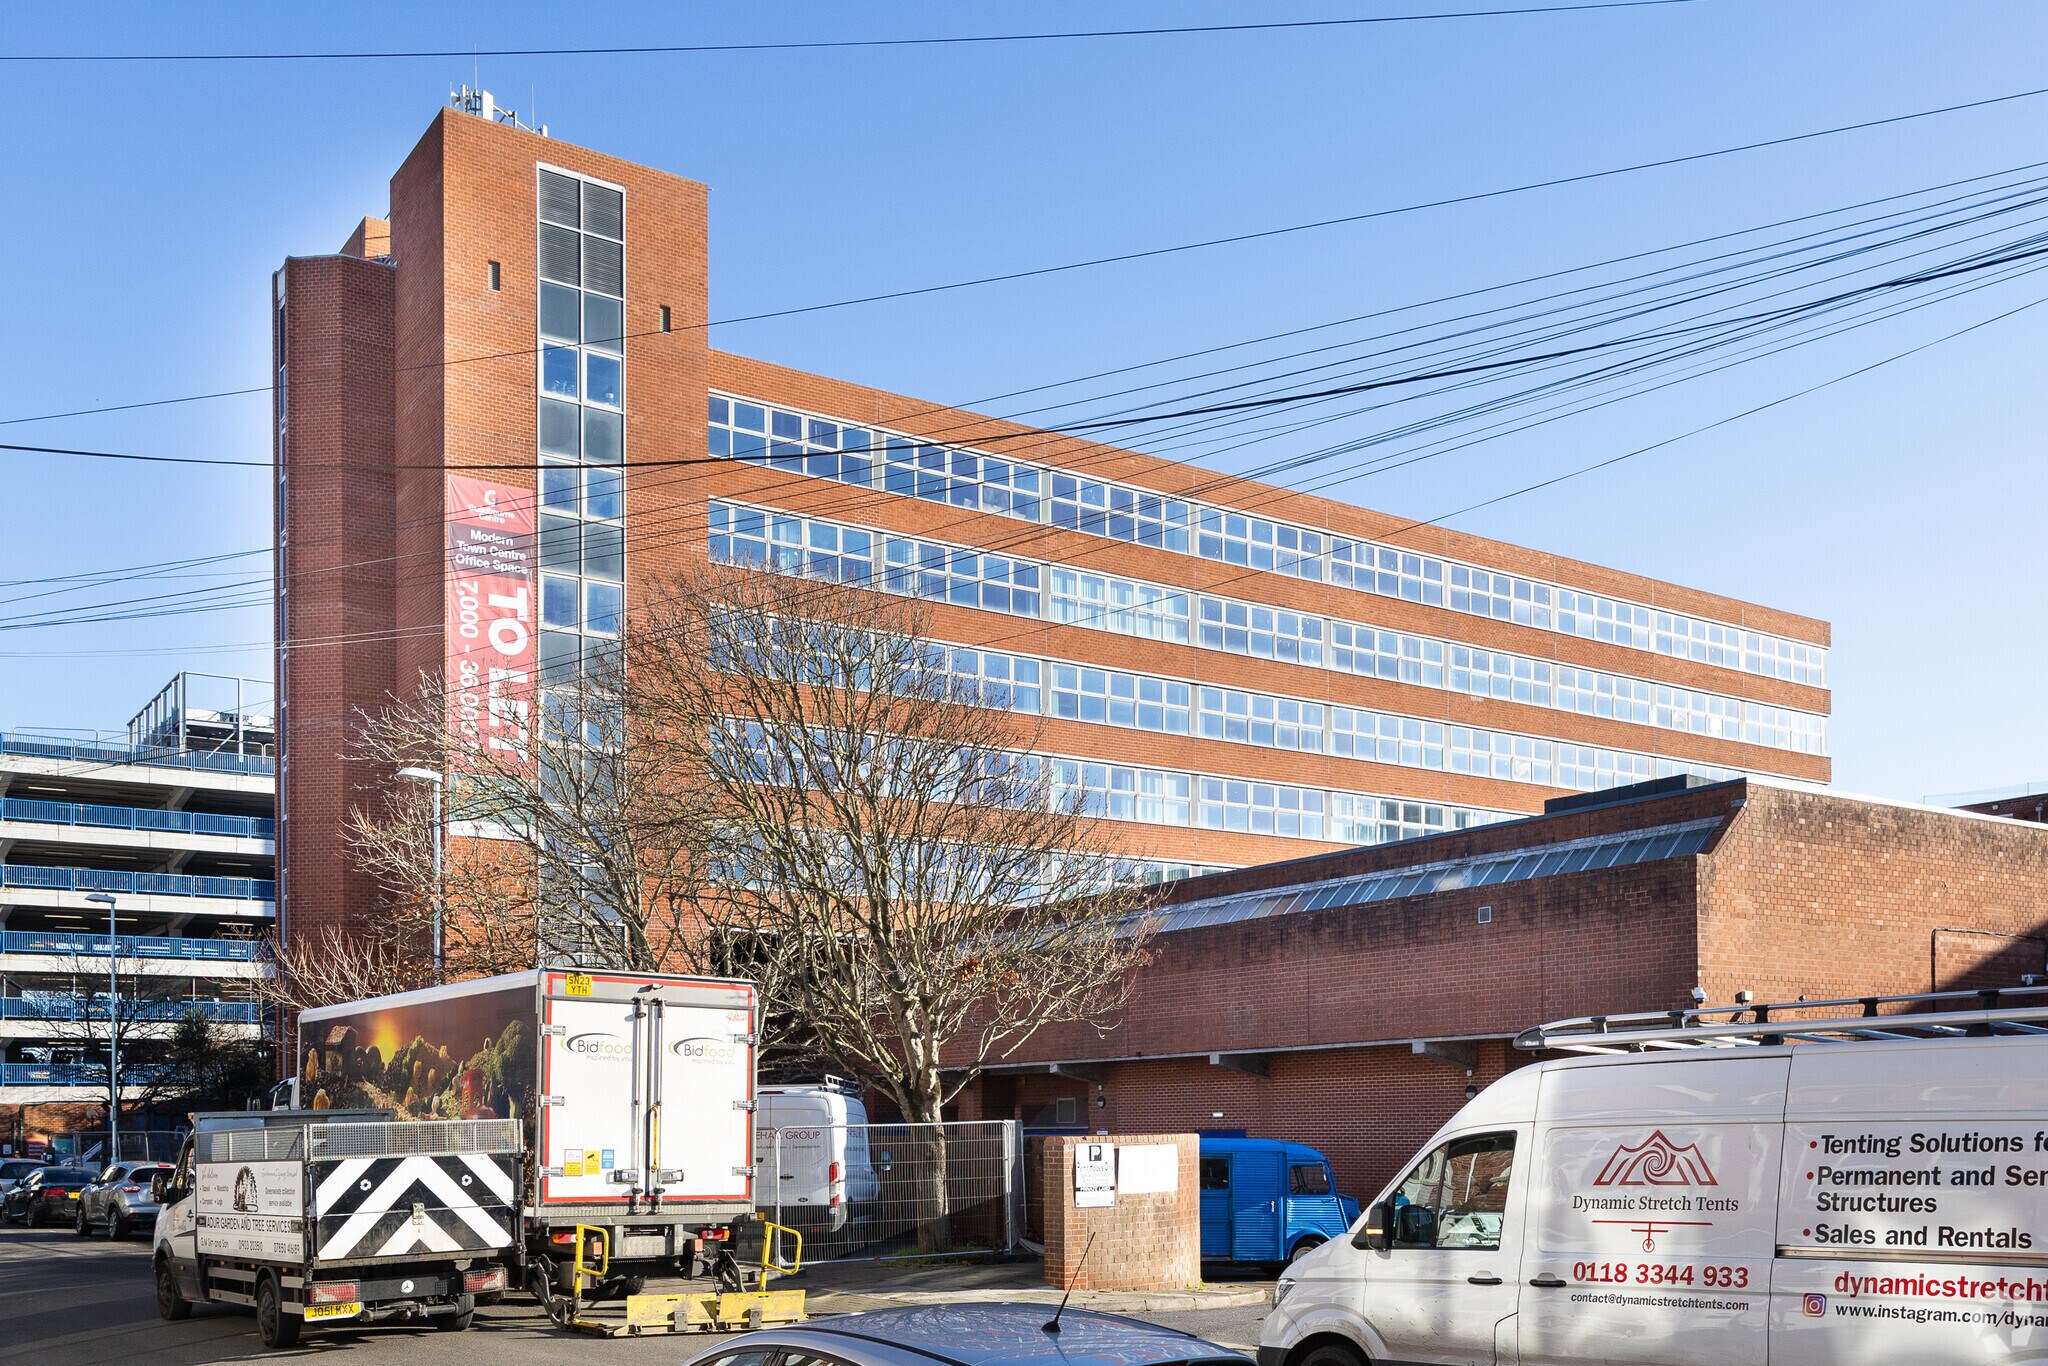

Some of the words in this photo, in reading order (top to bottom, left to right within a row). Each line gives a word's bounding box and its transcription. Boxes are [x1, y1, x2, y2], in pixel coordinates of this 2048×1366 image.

[479, 513, 505, 524] Centre
[470, 529, 514, 546] Modern
[456, 540, 487, 555] Town
[489, 545, 527, 561] Centre
[455, 553, 490, 568] Office
[492, 559, 528, 574] Space
[456, 580, 479, 639] 7,000
[488, 586, 528, 656] TO
[488, 667, 529, 763] LET
[568, 975, 590, 985] SN23
[571, 985, 588, 994] YTH
[577, 1039, 633, 1054] Bidfood
[684, 1043, 735, 1057] Bidfood
[785, 1130, 821, 1140] GROUP
[1821, 1134, 1902, 1158] Tenting
[1909, 1132, 2024, 1153] Solutions
[1817, 1165, 1942, 1186] Permanent
[1950, 1165, 1996, 1186] and
[1572, 1195, 1635, 1213] Dynamic
[1638, 1195, 1692, 1211] Stretch
[1696, 1197, 1739, 1211] Tents
[1816, 1191, 1938, 1213] Structures
[207, 1216, 220, 1228] ADUR
[221, 1217, 240, 1230] GARDEN
[241, 1217, 251, 1231] AND
[252, 1218, 265, 1231] TREE
[266, 1219, 291, 1233] SERVICES
[1815, 1223, 1876, 1245] Sales
[1885, 1225, 1928, 1246] and
[1937, 1225, 2033, 1249] Rentals
[1573, 1261, 1628, 1283] 0118
[1635, 1263, 1694, 1286] 3344
[1703, 1265, 1749, 1289] 933
[1570, 1293, 1750, 1311] contact@dynamicstretchtents.com
[1835, 1304, 2048, 1329] www.instagram.com/dyna
